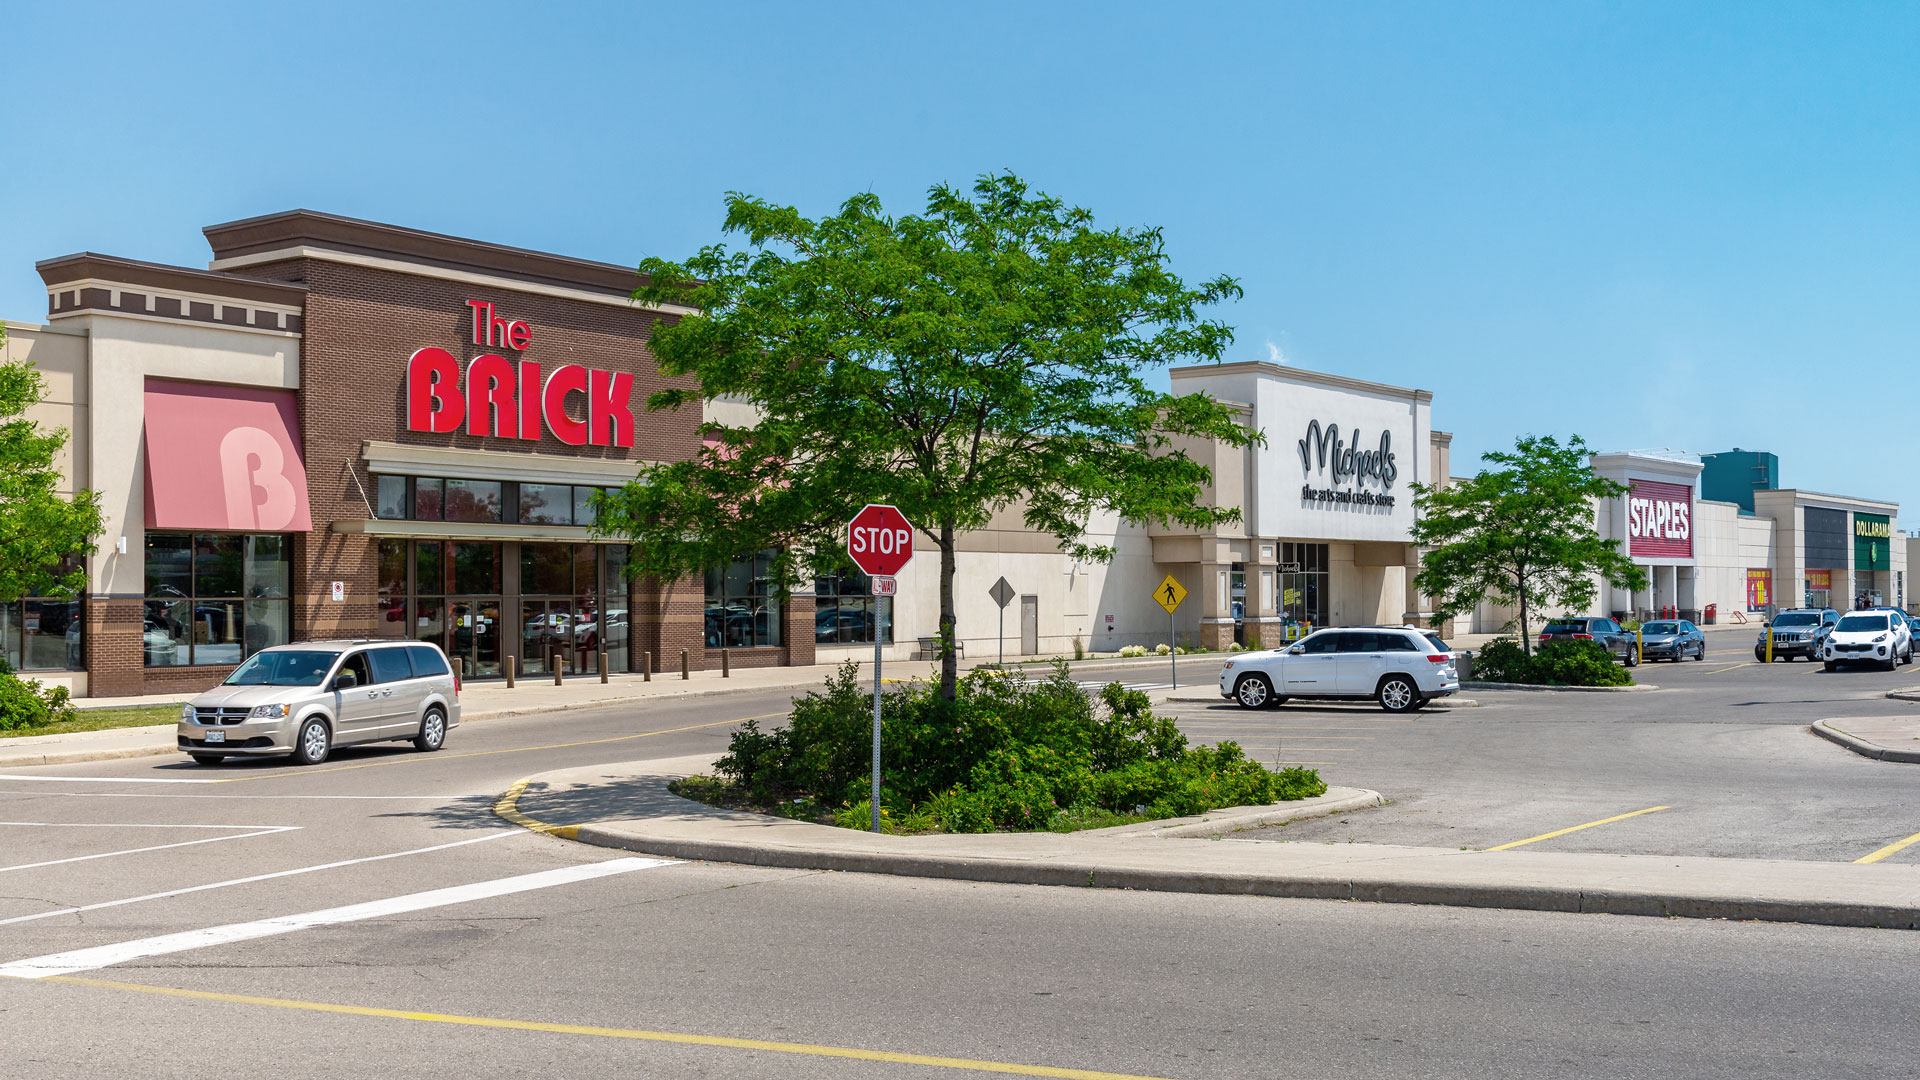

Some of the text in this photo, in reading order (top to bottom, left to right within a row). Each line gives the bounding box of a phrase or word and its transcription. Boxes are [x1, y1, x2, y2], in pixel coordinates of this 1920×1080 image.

[465, 300, 531, 350] The
[406, 347, 635, 448] BRICK
[1298, 418, 1398, 489] Michaels
[1302, 483, 1395, 507] the arts and crafts store
[853, 526, 909, 554] STOP
[1630, 498, 1689, 540] STAPLES
